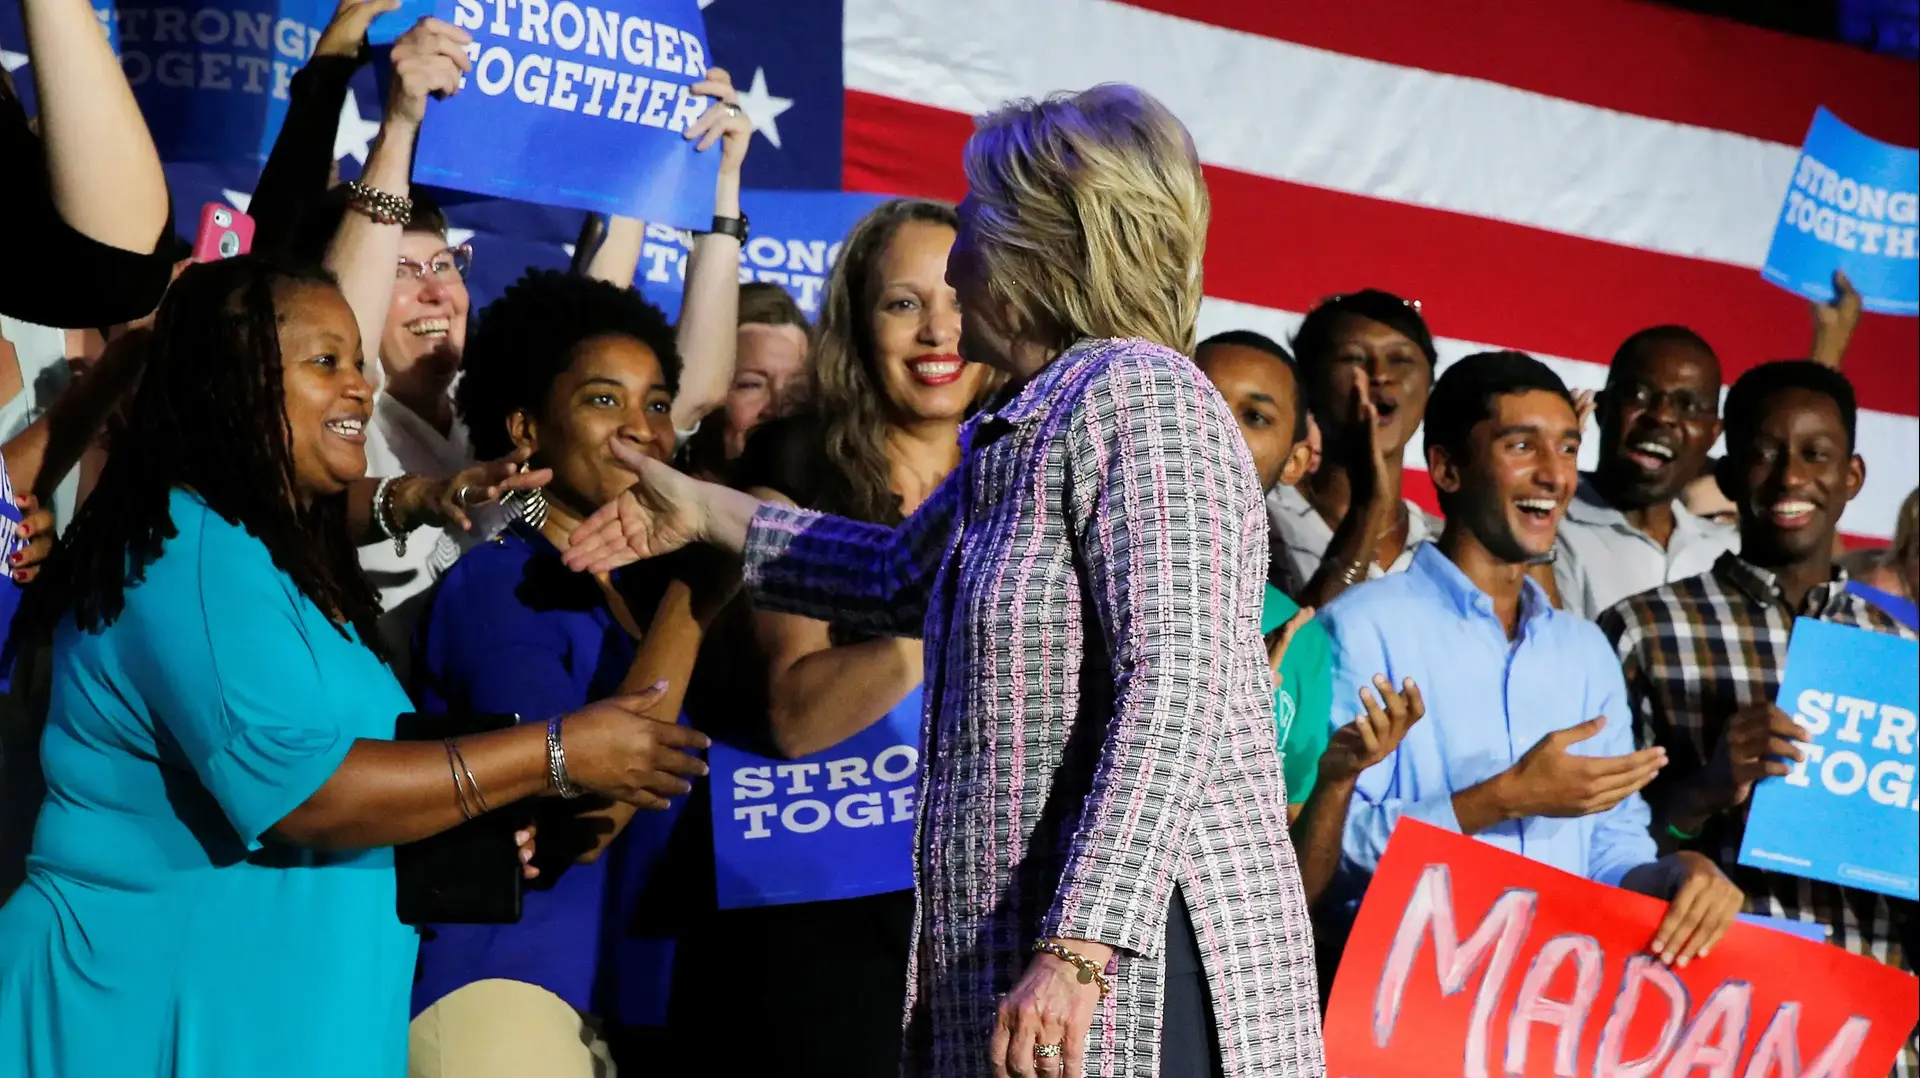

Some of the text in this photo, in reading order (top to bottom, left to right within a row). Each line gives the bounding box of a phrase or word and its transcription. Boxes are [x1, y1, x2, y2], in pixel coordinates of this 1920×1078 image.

[455, 0, 708, 77] STRONGER
[1785, 190, 1919, 259] TOGETH
[1793, 688, 1919, 755] STR
[733, 744, 919, 801] STRO
[1784, 740, 1919, 811] TOG
[1371, 862, 1872, 1078] MADAM
